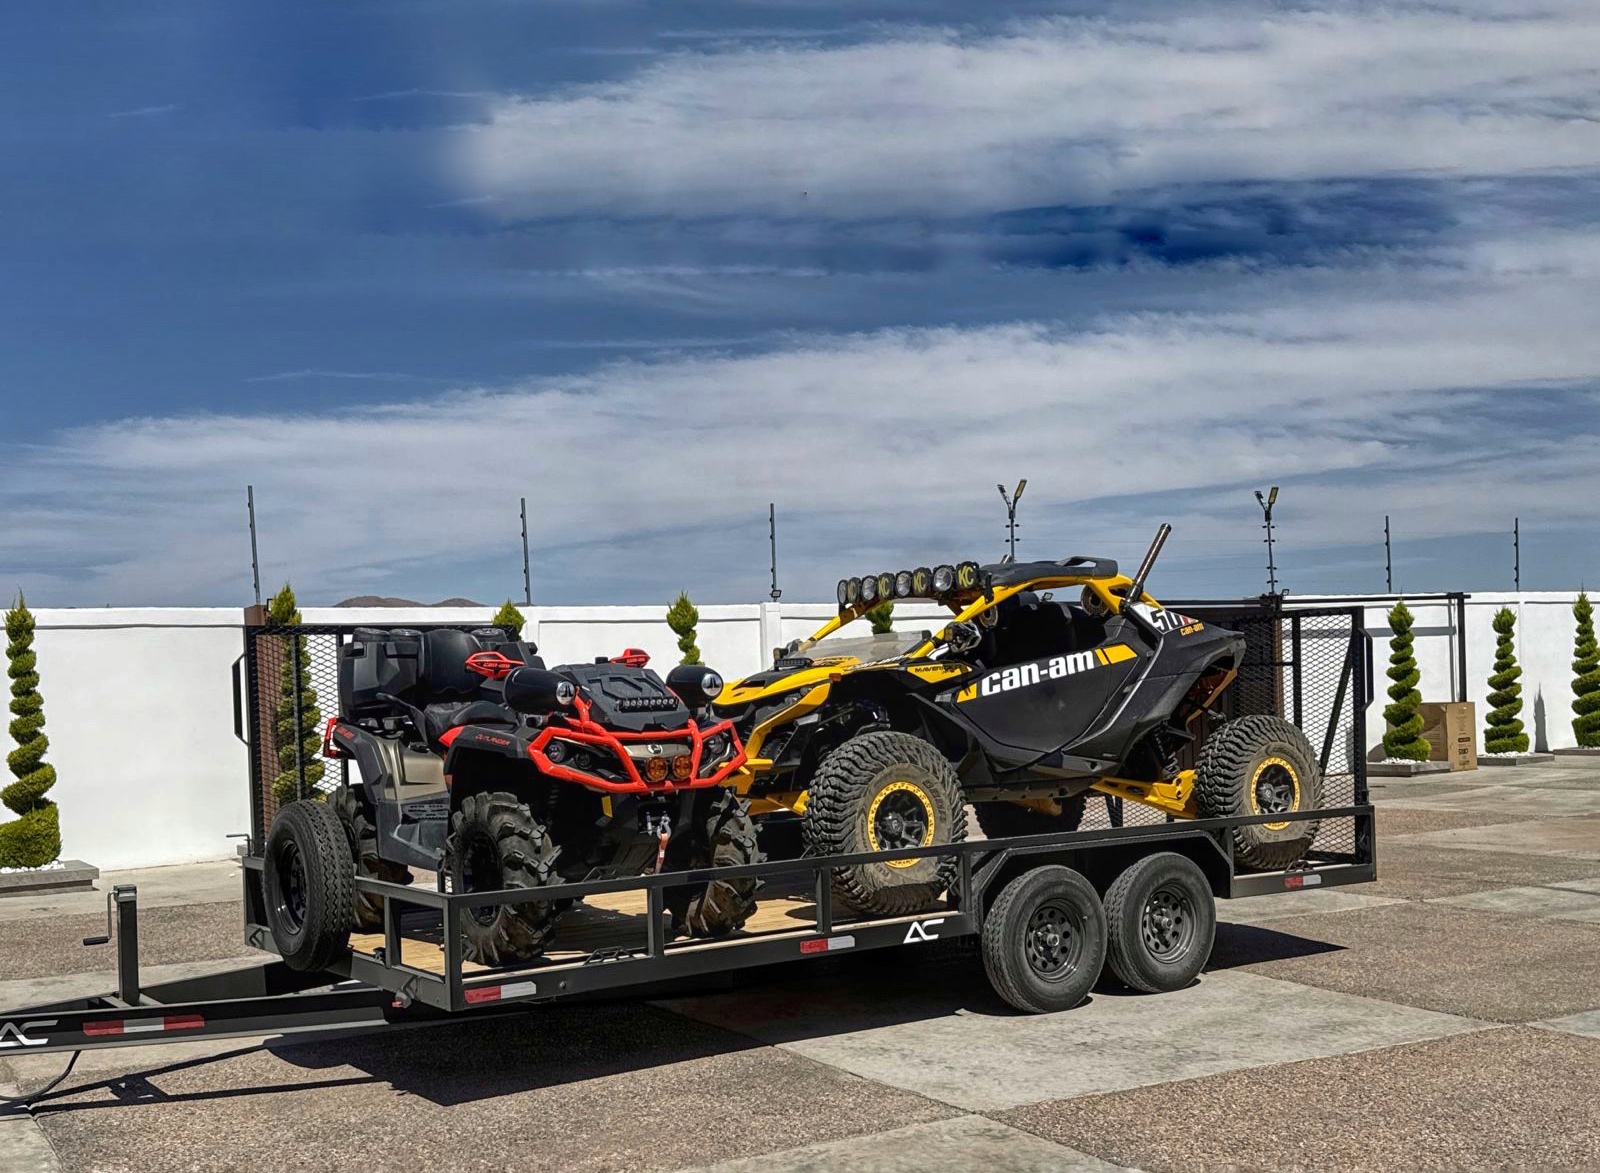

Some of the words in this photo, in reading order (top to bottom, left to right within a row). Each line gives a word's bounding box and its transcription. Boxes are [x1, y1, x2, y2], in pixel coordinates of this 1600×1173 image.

[914, 572, 926, 592] KC
[958, 565, 973, 587] KC
[879, 578, 890, 596] KC
[1180, 622, 1205, 636] can-am
[981, 650, 1094, 696] can-am
[903, 918, 945, 944] AC
